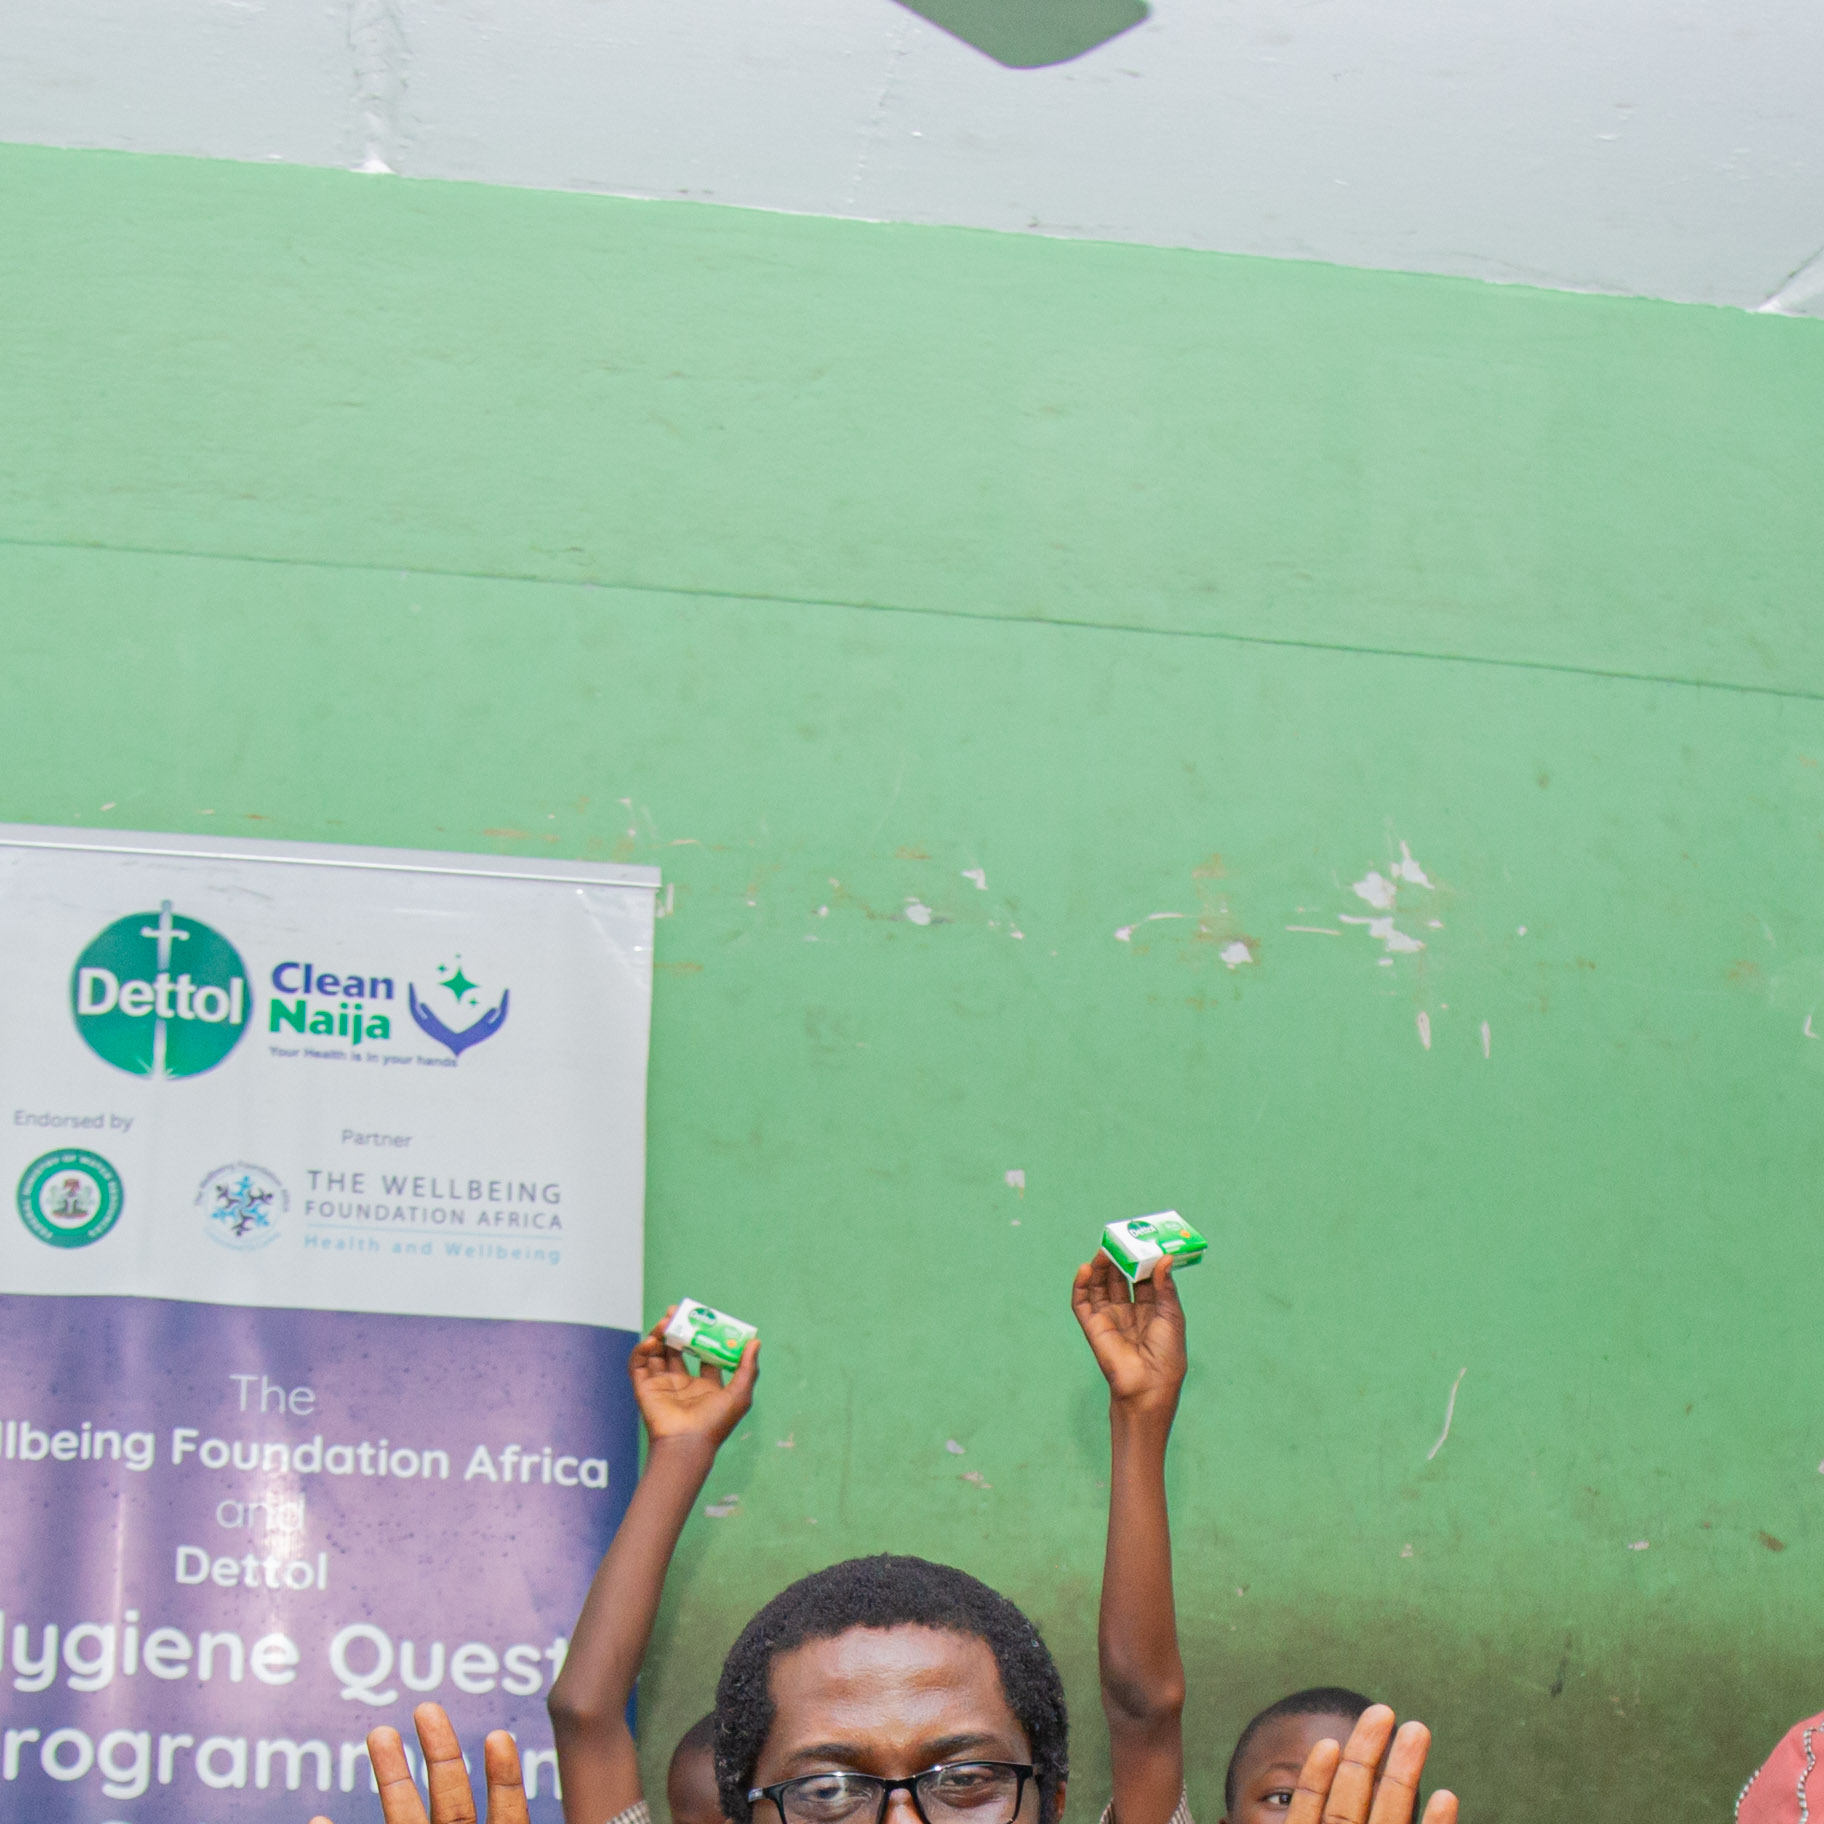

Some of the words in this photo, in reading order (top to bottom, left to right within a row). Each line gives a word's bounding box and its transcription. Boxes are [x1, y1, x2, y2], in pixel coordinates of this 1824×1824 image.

[78, 966, 243, 1026] Dettol
[271, 961, 395, 1000] Clean
[269, 998, 391, 1045] Naija
[269, 1046, 300, 1058] Your
[304, 1047, 347, 1060] Health
[350, 1051, 362, 1061] is
[366, 1052, 379, 1063] in
[382, 1055, 413, 1067] your
[416, 1055, 458, 1068] hands
[13, 1109, 105, 1129] Endorsed
[110, 1113, 134, 1133] by
[341, 1129, 413, 1148] Partner
[306, 1170, 365, 1194] THE
[381, 1174, 562, 1204] WELLBEING
[304, 1200, 465, 1226] FOUNDATION
[477, 1210, 563, 1230] AFRICA
[303, 1234, 380, 1252] Health
[391, 1241, 433, 1256] and
[444, 1242, 561, 1265] Wellbeing
[229, 1373, 316, 1417] The
[170, 1426, 451, 1482] Foundation
[464, 1441, 610, 1491] Africa
[215, 1489, 307, 1535] and
[175, 1544, 329, 1592] Dettol
